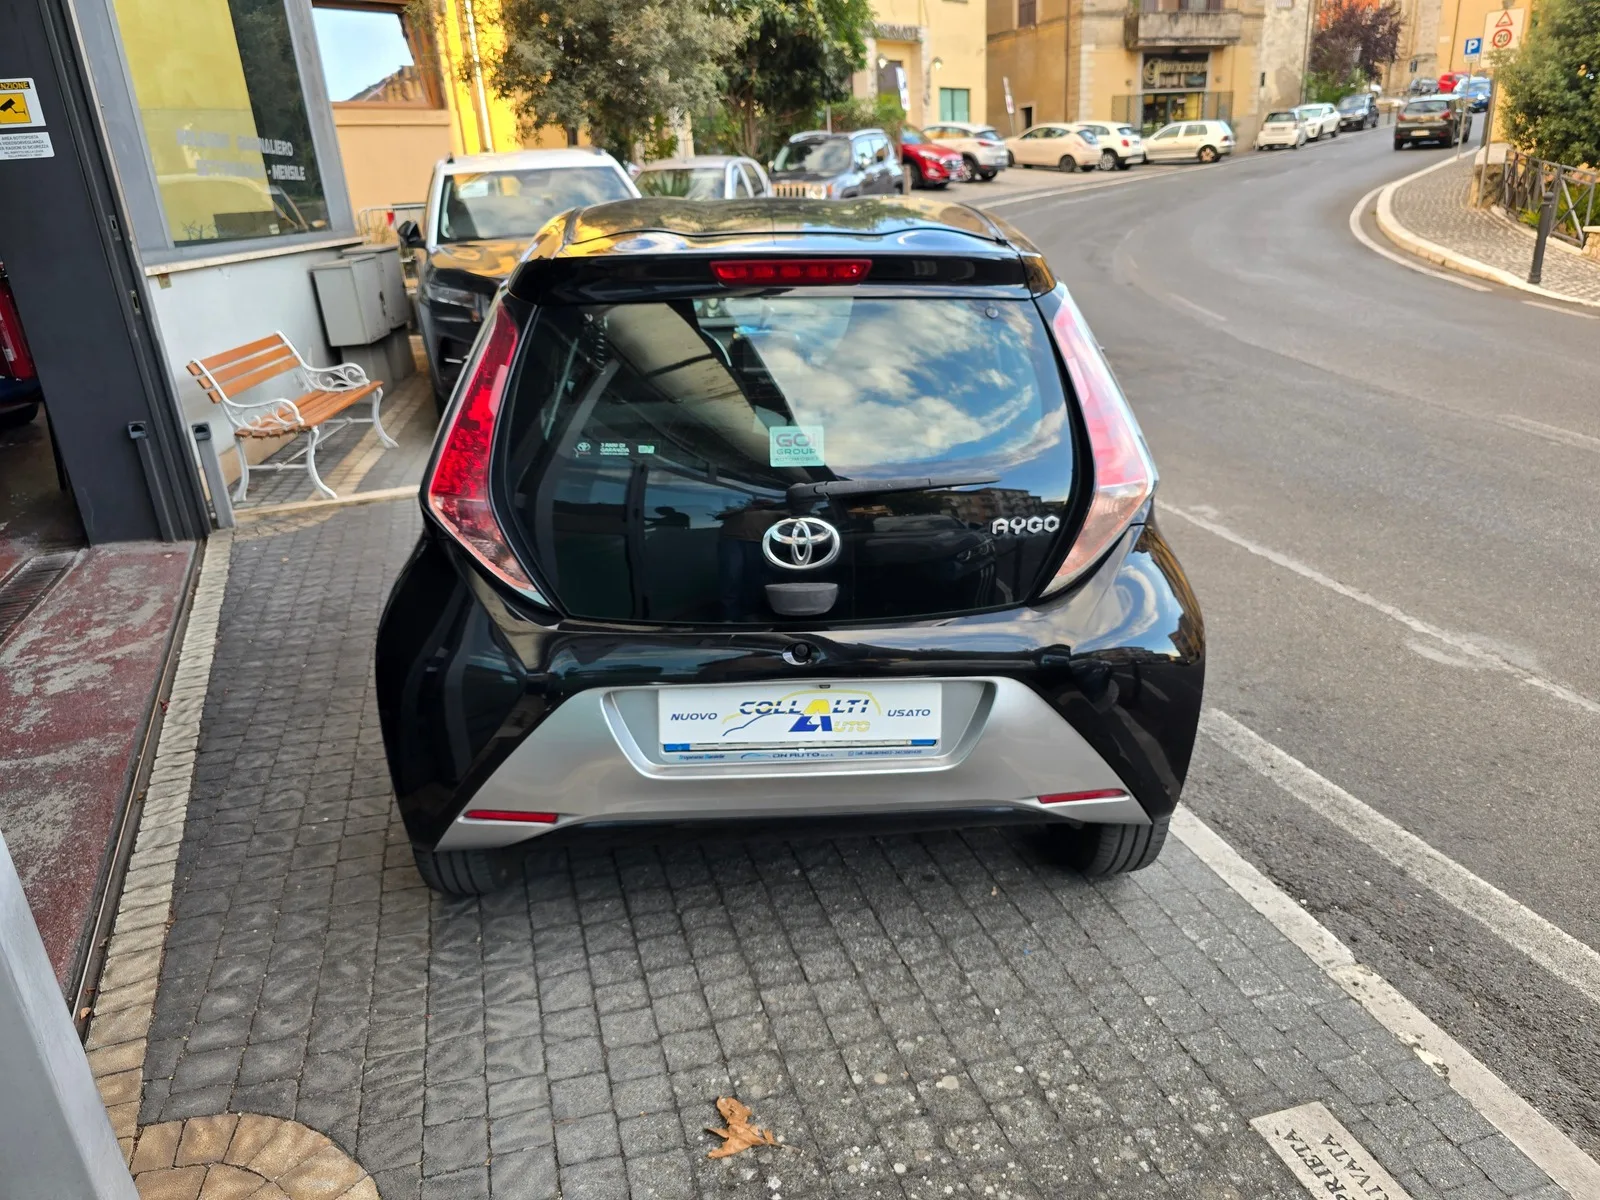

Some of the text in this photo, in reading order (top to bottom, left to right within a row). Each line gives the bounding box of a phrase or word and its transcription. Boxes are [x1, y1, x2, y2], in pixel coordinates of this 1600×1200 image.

[1497, 33, 1509, 43] 20
[1467, 40, 1479, 54] P
[0, 81, 29, 90] NZIONE
[272, 164, 306, 181] MENSILE
[992, 515, 1060, 535] AYGO
[670, 712, 718, 721] NUOVO
[887, 708, 931, 717] USATO
